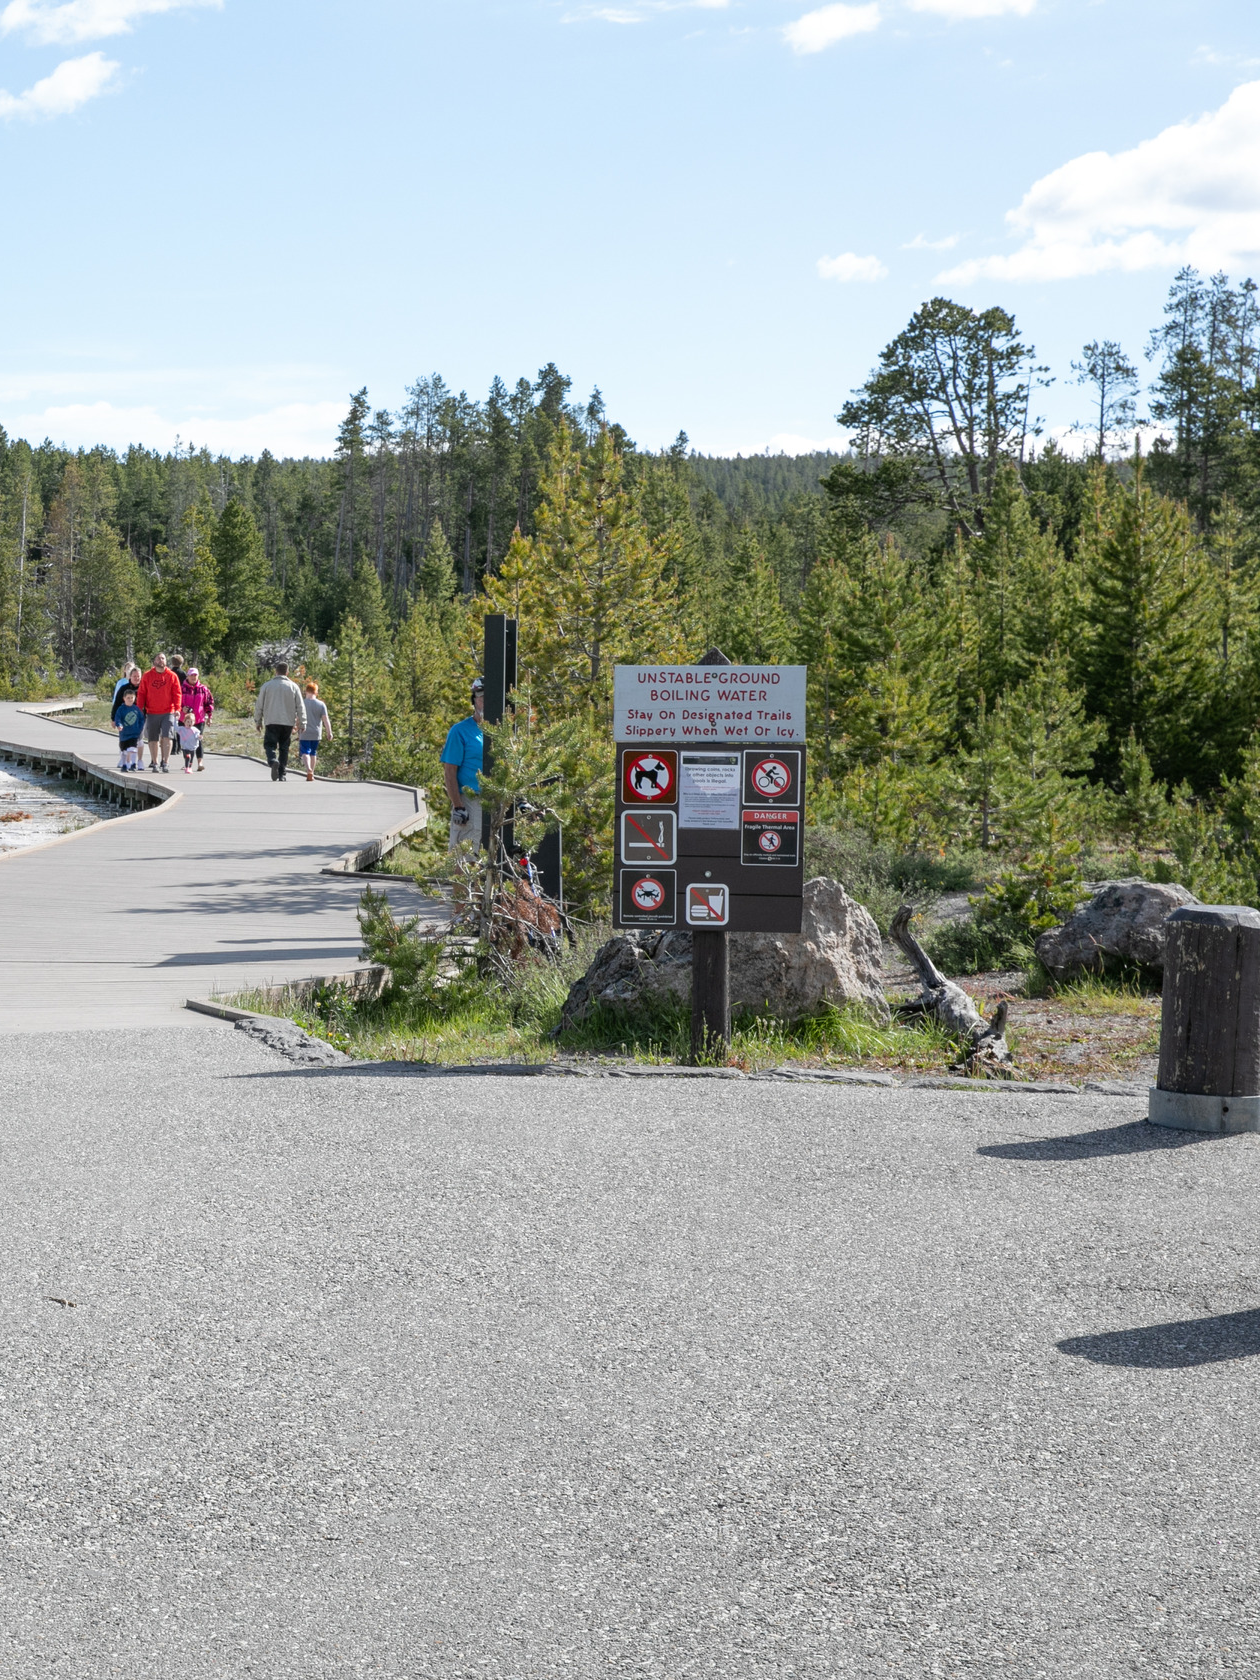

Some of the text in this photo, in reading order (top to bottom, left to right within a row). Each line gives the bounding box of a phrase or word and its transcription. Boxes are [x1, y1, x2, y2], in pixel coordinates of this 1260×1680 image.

[637, 671, 781, 685] UNSTABLE GROUND
[650, 689, 768, 702] BOILING WATER
[627, 708, 792, 723] Stay On Designated Trails
[625, 725, 800, 738] Slippery When Wet Or Icy.
[754, 812, 787, 820] DANGER
